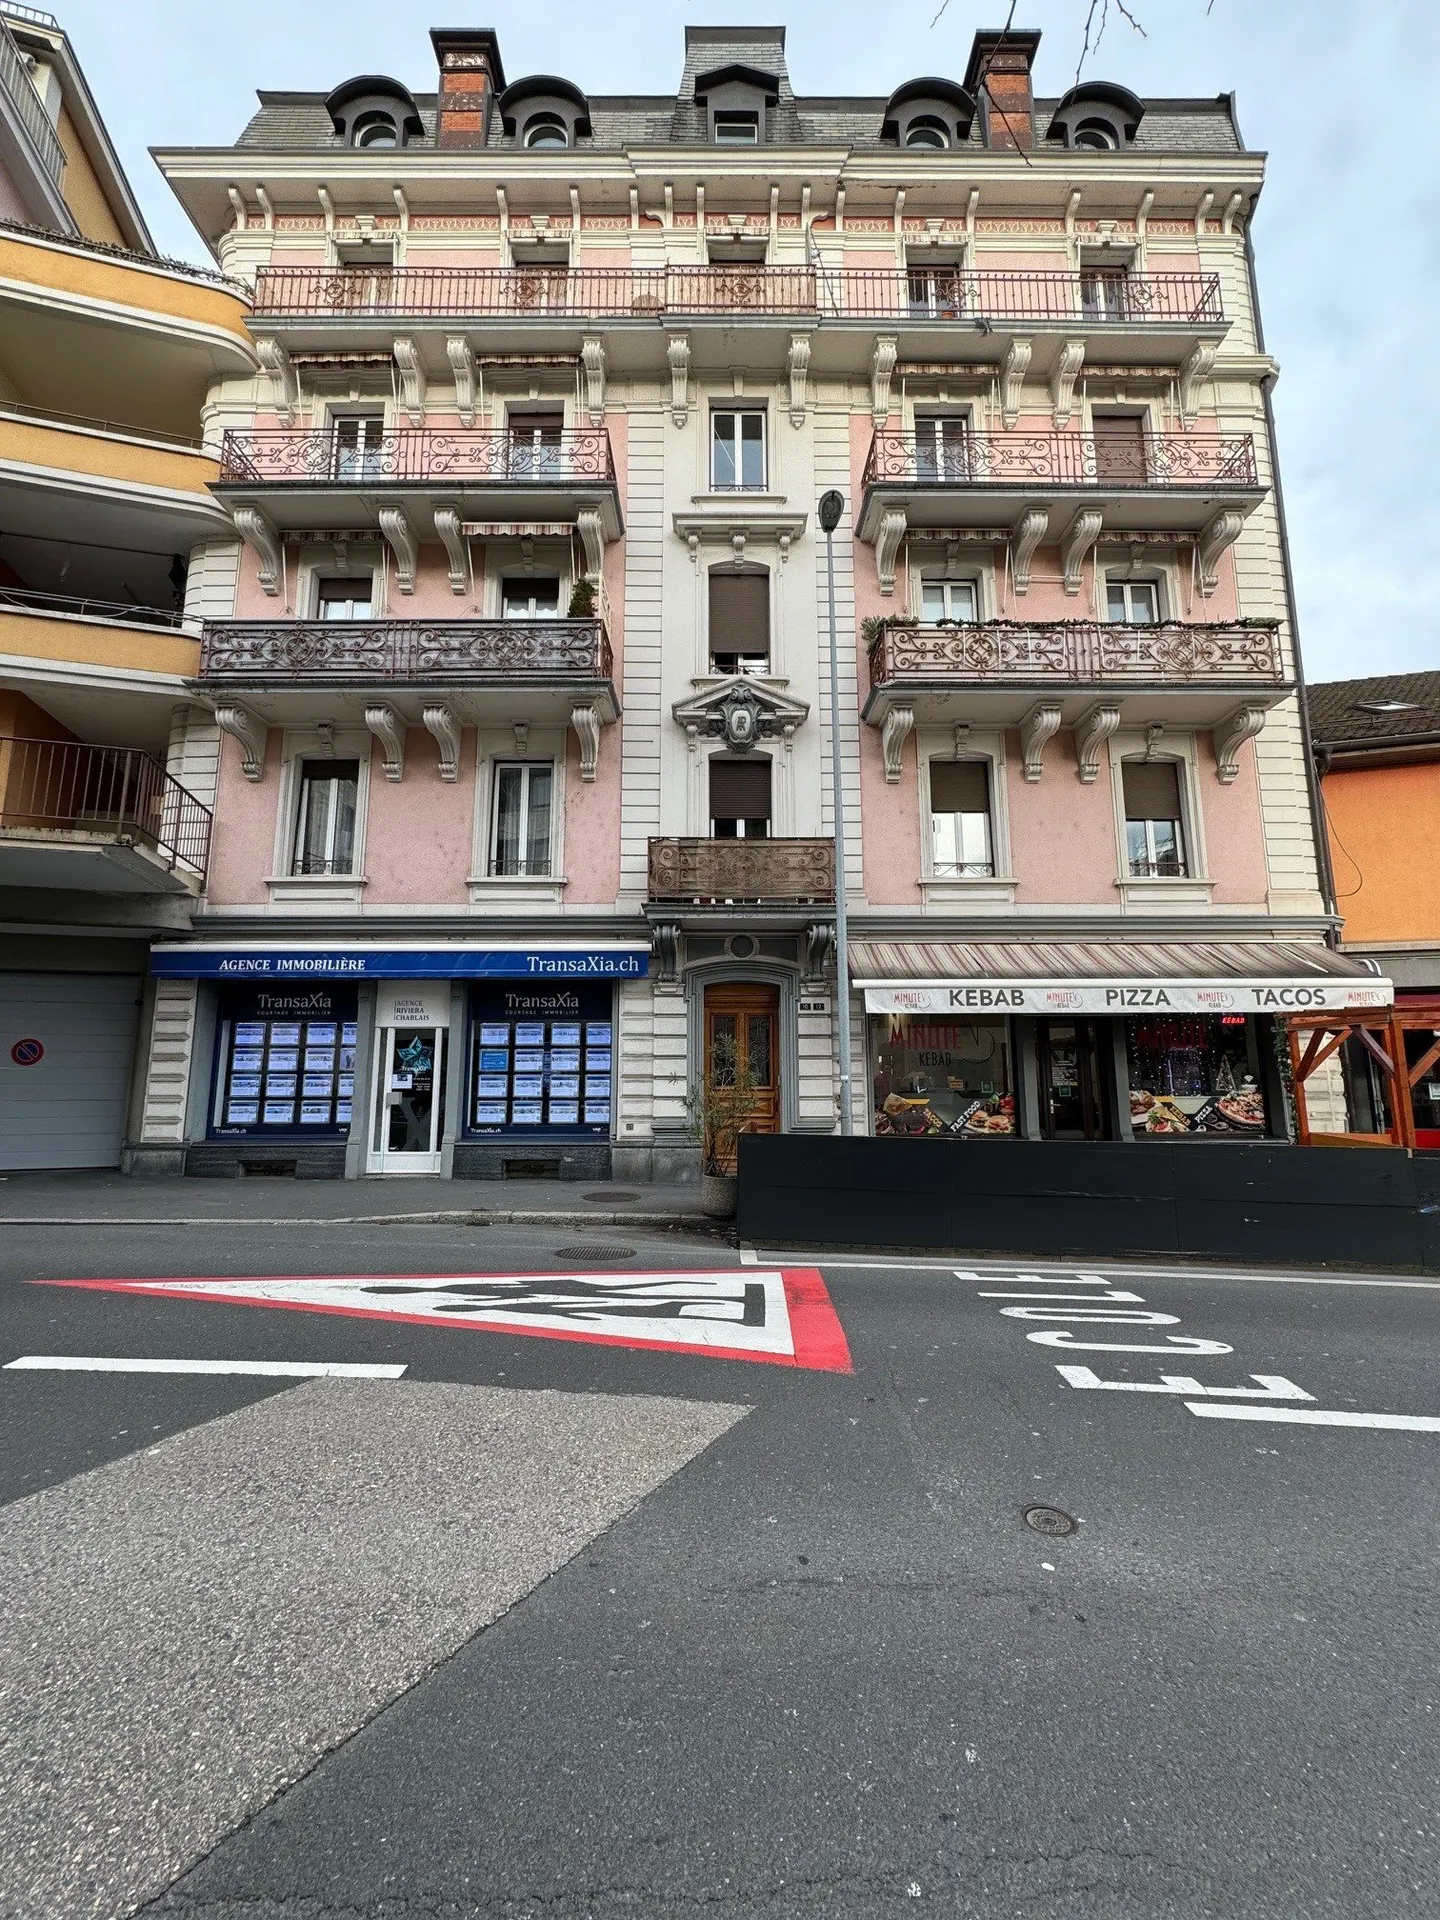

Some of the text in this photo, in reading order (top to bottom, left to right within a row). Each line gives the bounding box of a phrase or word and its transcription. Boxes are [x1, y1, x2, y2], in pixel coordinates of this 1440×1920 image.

[219, 957, 366, 970] AGENCE IMMOBILIÈRE
[526, 956, 639, 972] TransaXia.ch
[257, 992, 331, 1008] TransaXia
[505, 991, 579, 1008] TransaXia
[894, 992, 921, 1003] MINUTE
[949, 989, 1024, 1007] KEBAB
[1047, 992, 1073, 1002] MINUTE
[1105, 989, 1171, 1006] PIZZA
[1197, 992, 1224, 1002] MINUTE
[1251, 989, 1326, 1006] TACOS
[1348, 992, 1376, 1002] MINUTE
[1222, 1016, 1245, 1024] KEBAB
[889, 1022, 962, 1050] MINUTE
[919, 1052, 951, 1067] KEBAB
[923, 1107, 943, 1128] TACOS
[950, 1100, 981, 1132] FAST FOOD
[1194, 1106, 1213, 1124] PIZZA
